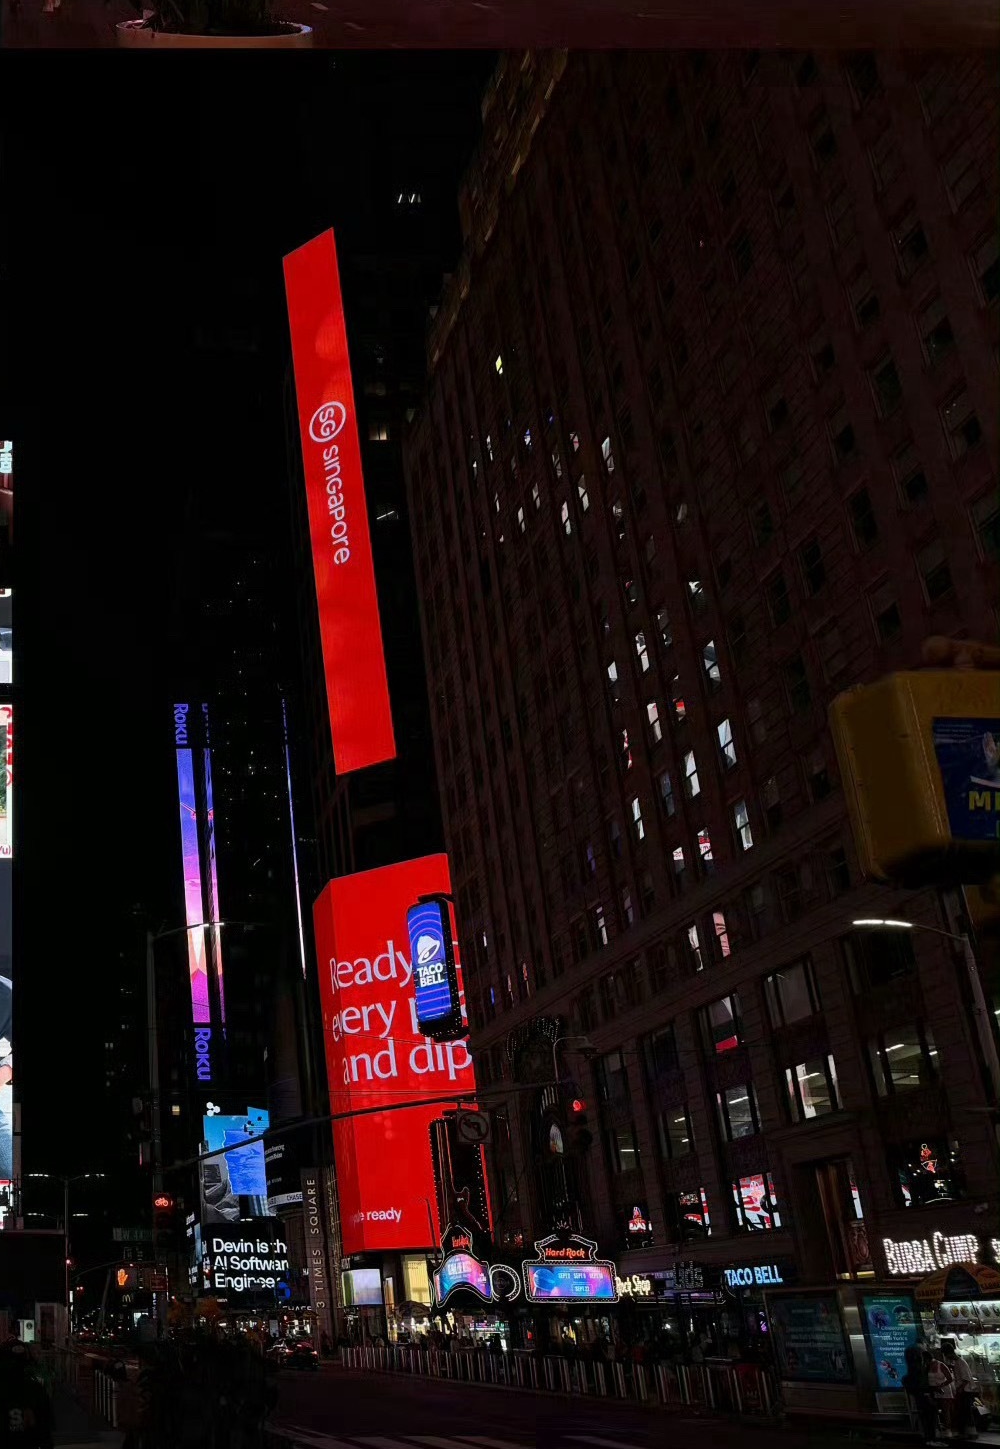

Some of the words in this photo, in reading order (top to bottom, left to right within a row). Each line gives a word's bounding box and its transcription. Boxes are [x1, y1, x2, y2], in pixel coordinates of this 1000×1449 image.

[329, 939, 413, 994] Ready
[417, 963, 444, 976] TACO
[419, 973, 445, 987] BELL
[332, 1000, 397, 1043] every
[342, 1038, 398, 1086] and
[408, 1036, 473, 1081] dip
[306, 1178, 320, 1235] SQUARE
[367, 1207, 402, 1222] ready
[212, 1238, 254, 1253] Devin
[256, 1238, 268, 1253] is
[545, 1247, 565, 1257] Hard
[566, 1247, 585, 1258] Rock
[882, 1238, 937, 1274] BUBBA
[312, 1249, 324, 1292] TIMES
[724, 1267, 754, 1287] TACO
[755, 1264, 783, 1284] BELL
